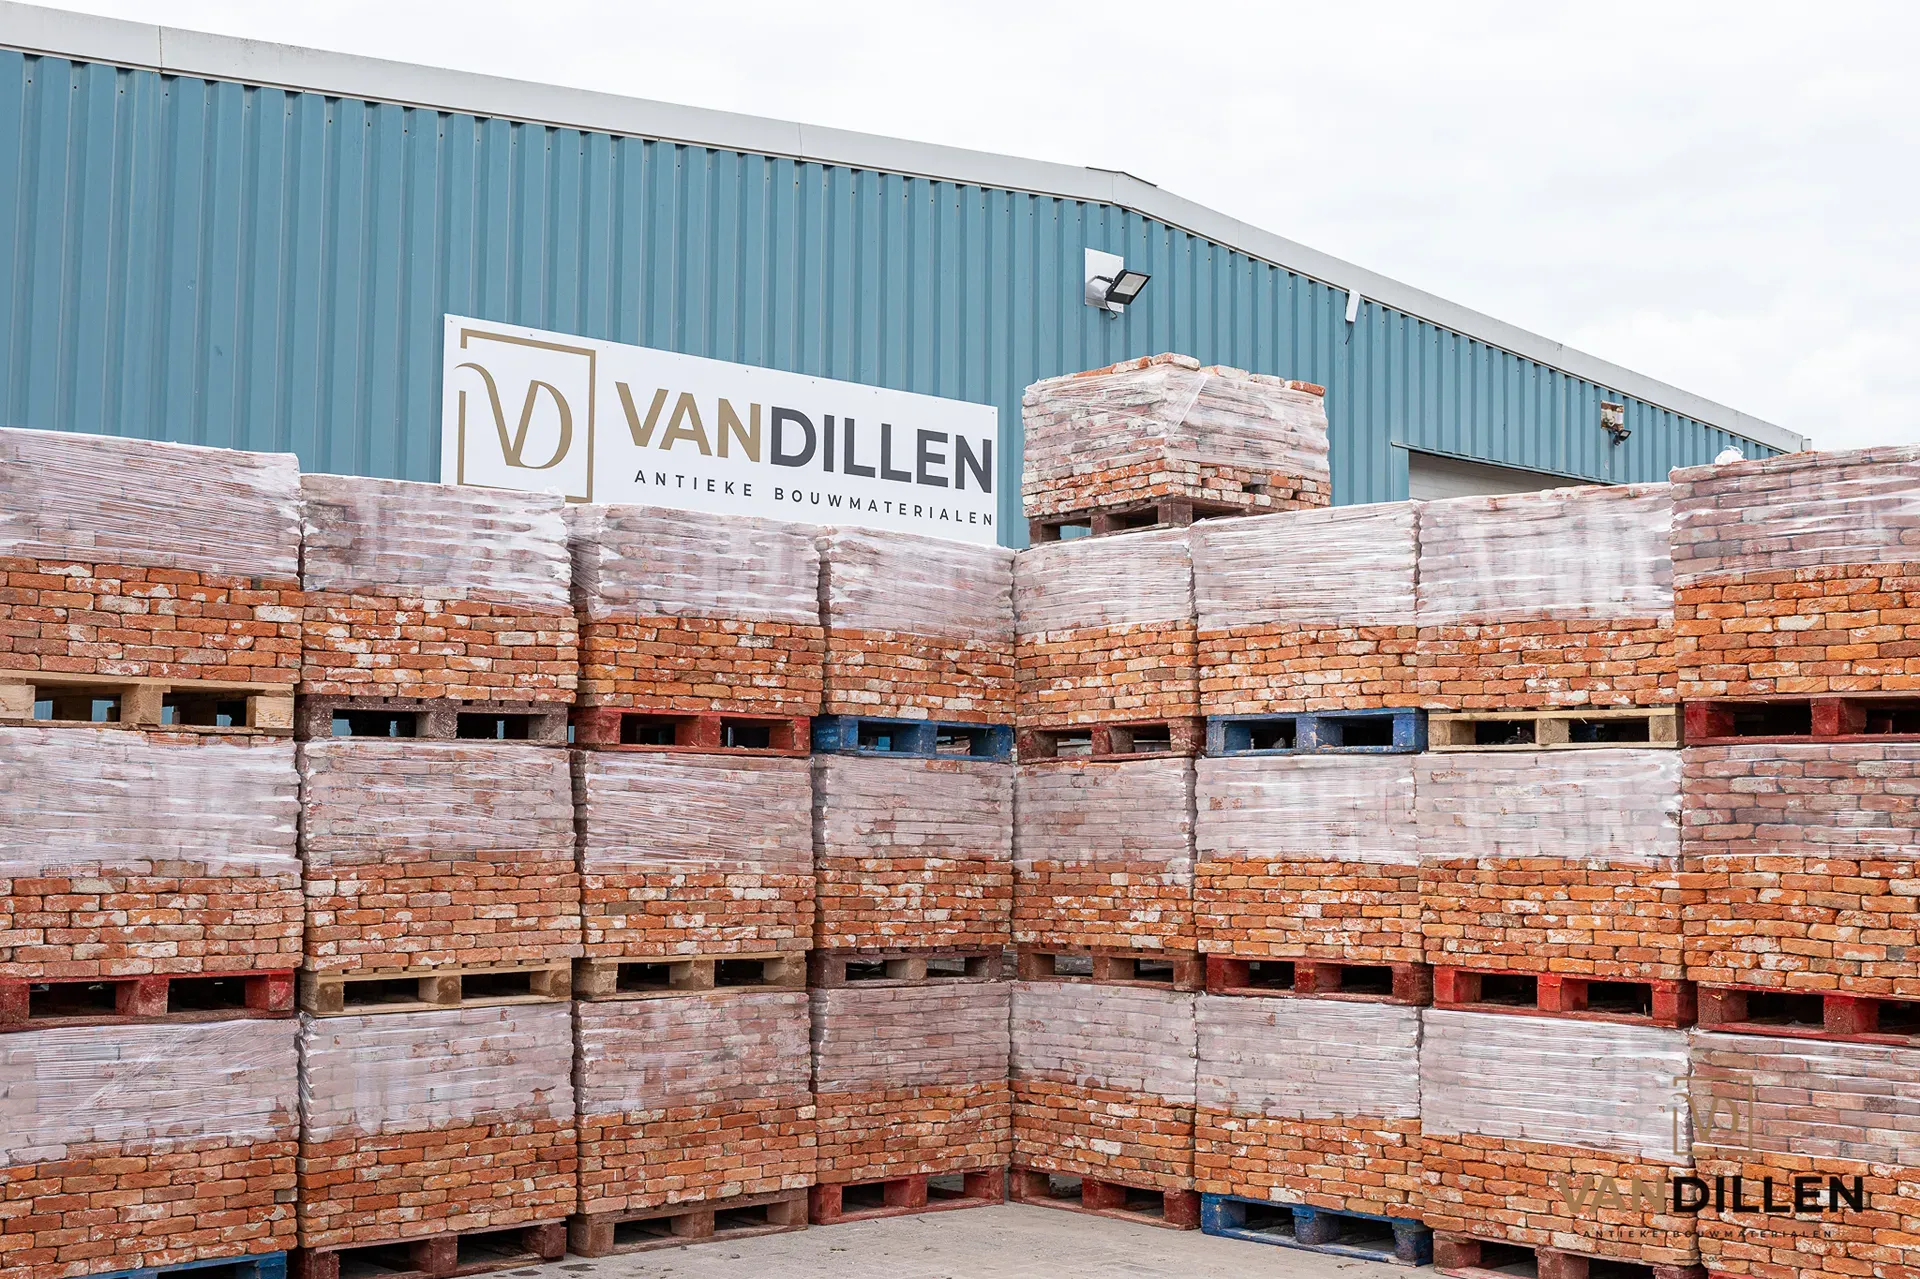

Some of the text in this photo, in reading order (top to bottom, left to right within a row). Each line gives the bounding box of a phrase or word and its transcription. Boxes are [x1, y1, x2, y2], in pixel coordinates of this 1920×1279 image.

[614, 381, 993, 494] VANDILLEN
[634, 469, 993, 526] ANTIEKE BOUWMATERIALEN
